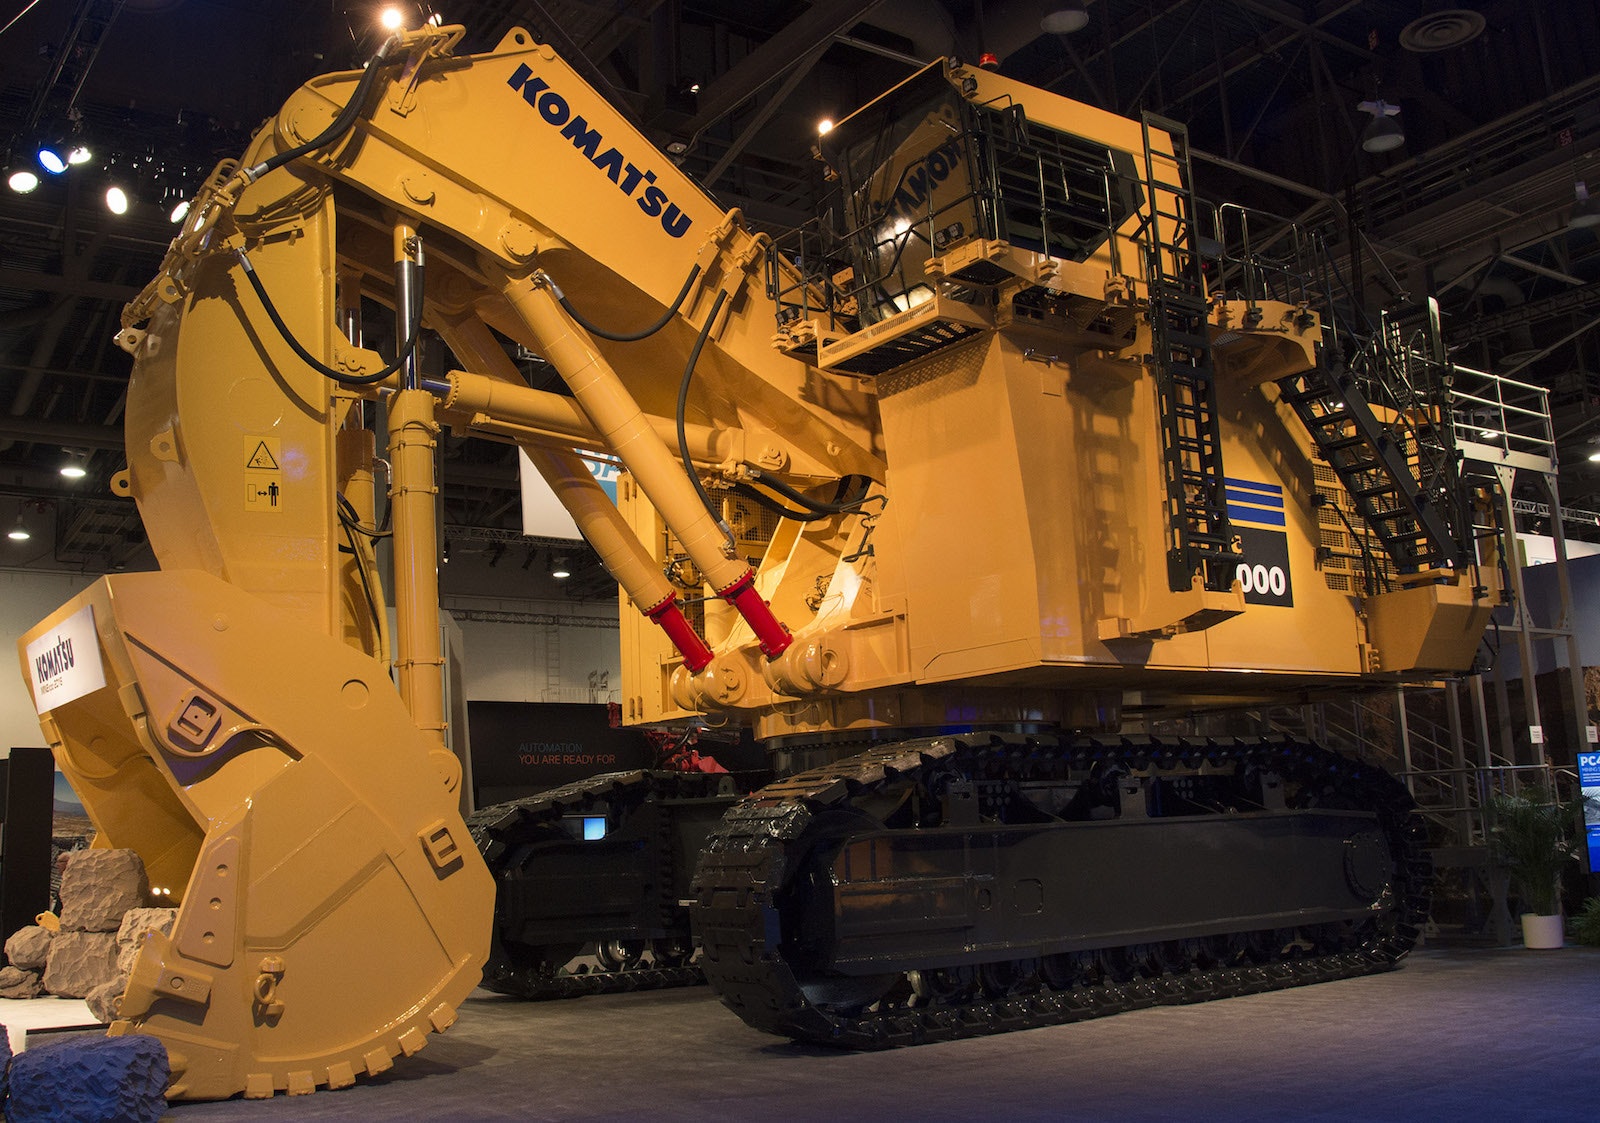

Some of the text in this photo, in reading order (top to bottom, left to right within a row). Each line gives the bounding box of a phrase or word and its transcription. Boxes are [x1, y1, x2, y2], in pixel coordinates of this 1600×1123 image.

[507, 62, 693, 238] KOMATSU
[35, 635, 75, 684] KOMATSU
[519, 743, 583, 752] AUTOMATION
[519, 754, 616, 764] YOU ARE READY FOR
